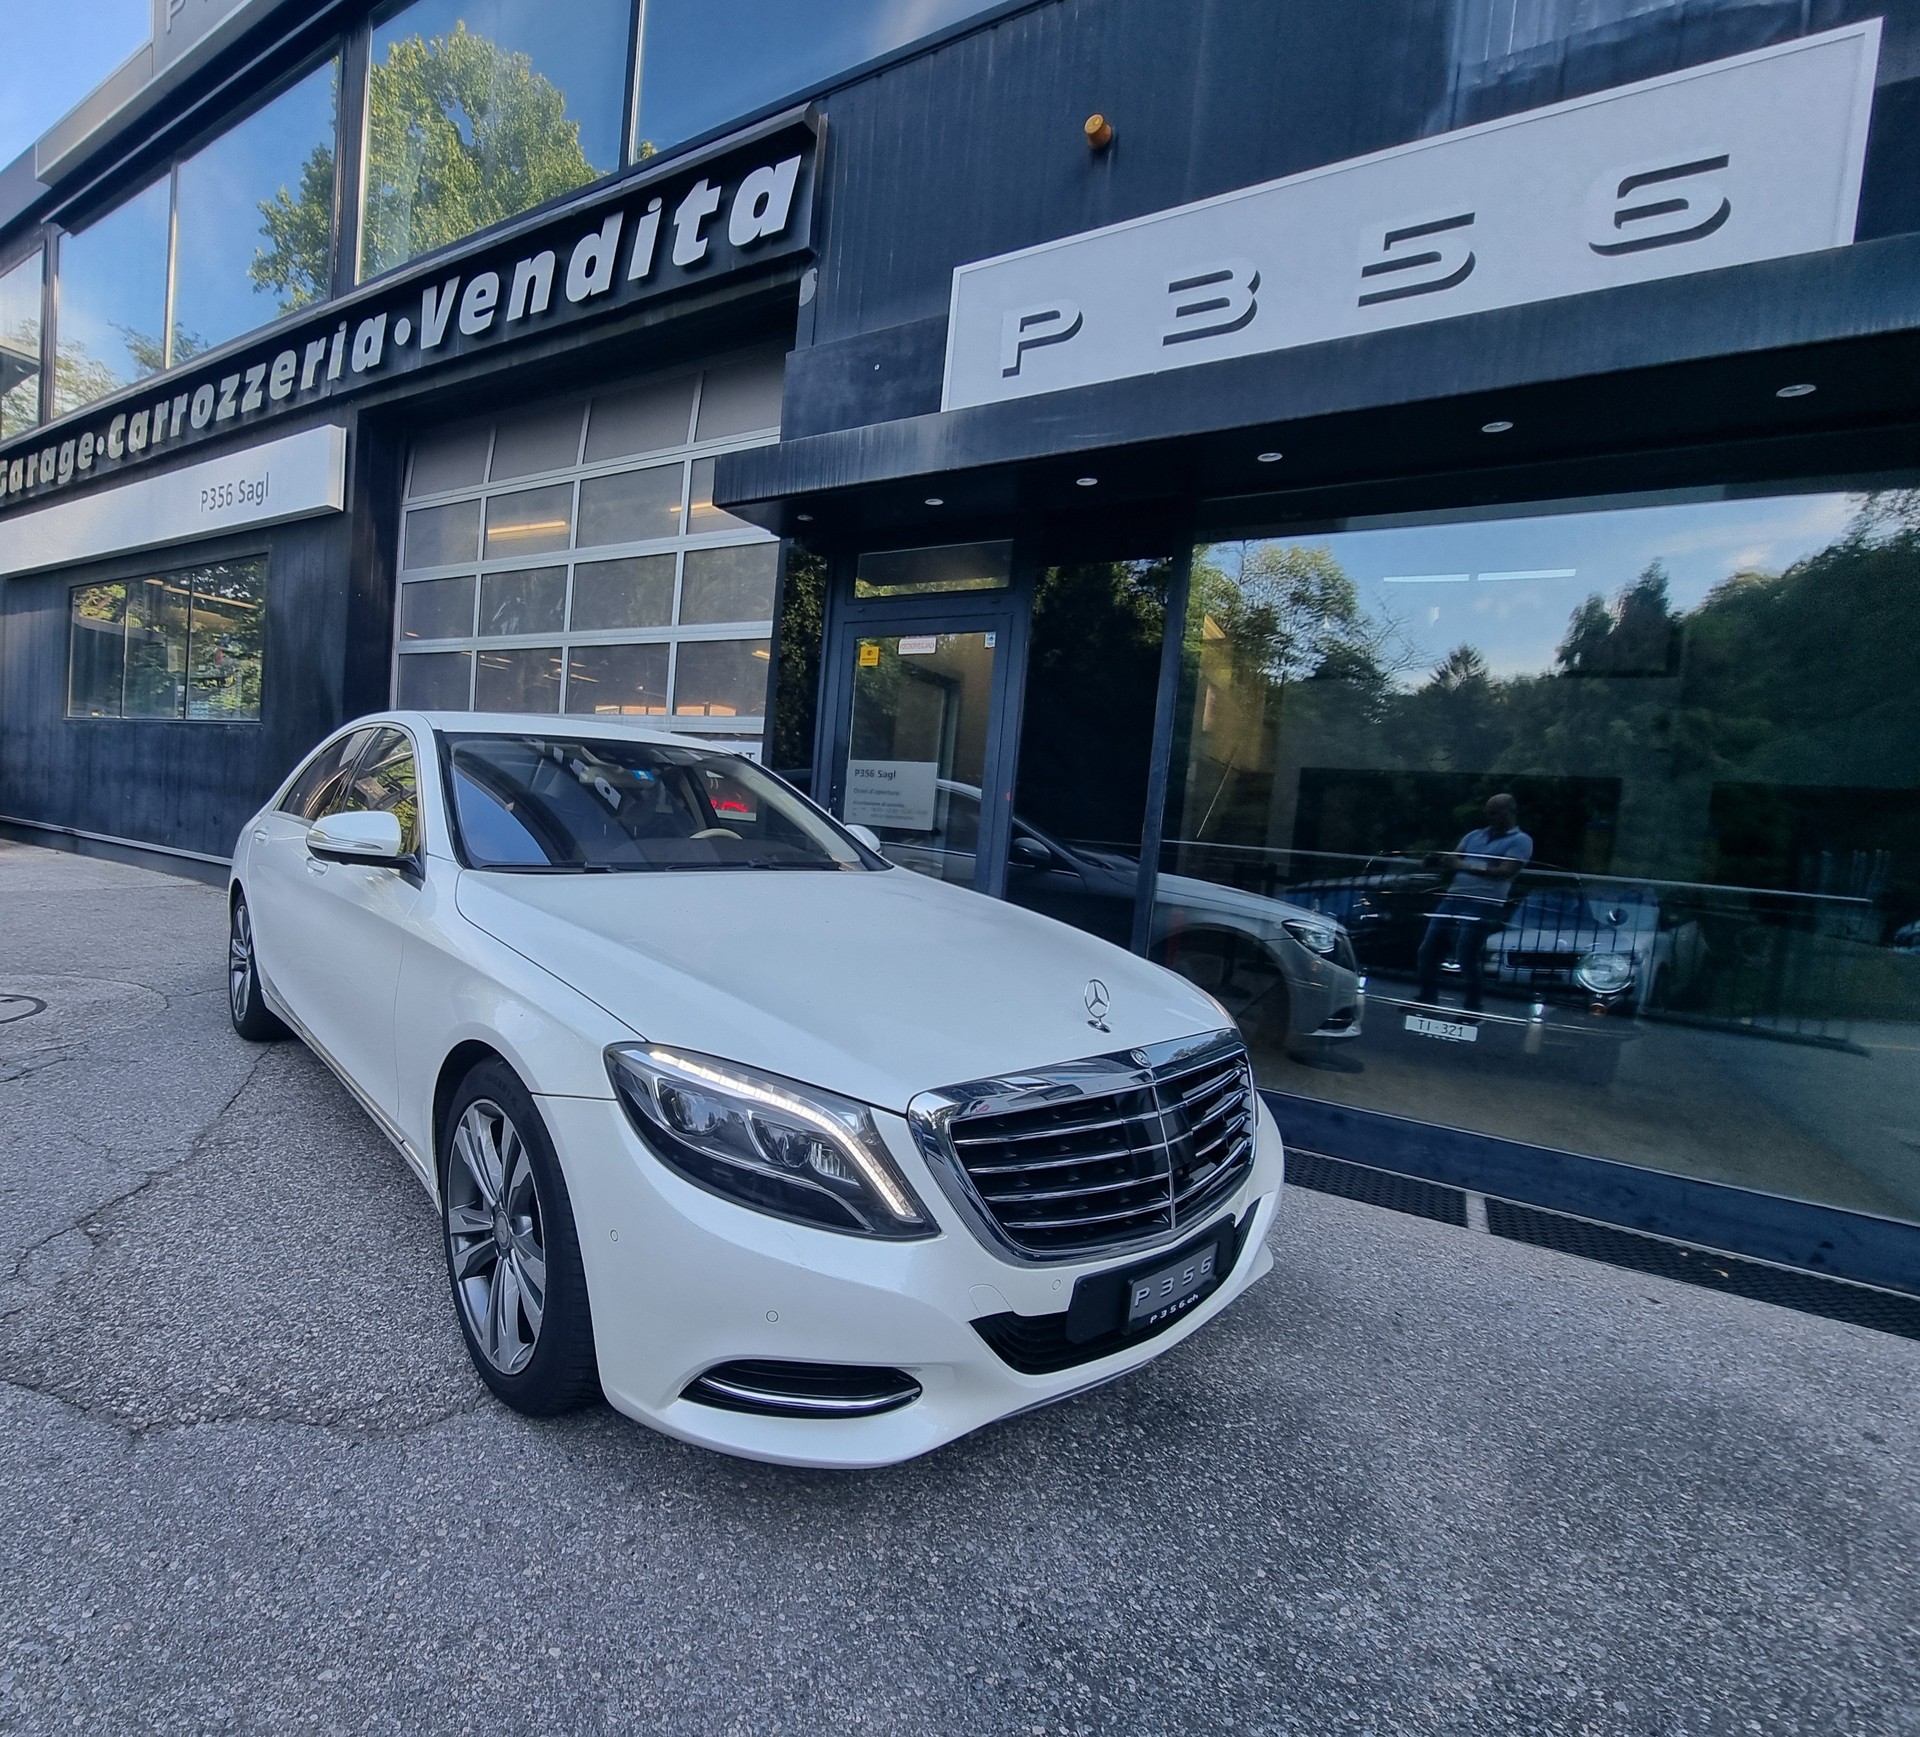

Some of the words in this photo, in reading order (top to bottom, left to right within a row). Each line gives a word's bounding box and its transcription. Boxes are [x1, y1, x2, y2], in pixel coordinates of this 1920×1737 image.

[1001, 145, 1731, 379] P356
[108, 312, 387, 459] Carrozzeria
[419, 154, 801, 348] Vendita
[200, 482, 233, 513] P356
[237, 471, 269, 507] Sagl
[854, 768, 875, 778] P356
[877, 769, 896, 781] Sagl
[1134, 1255, 1213, 1308] P356
